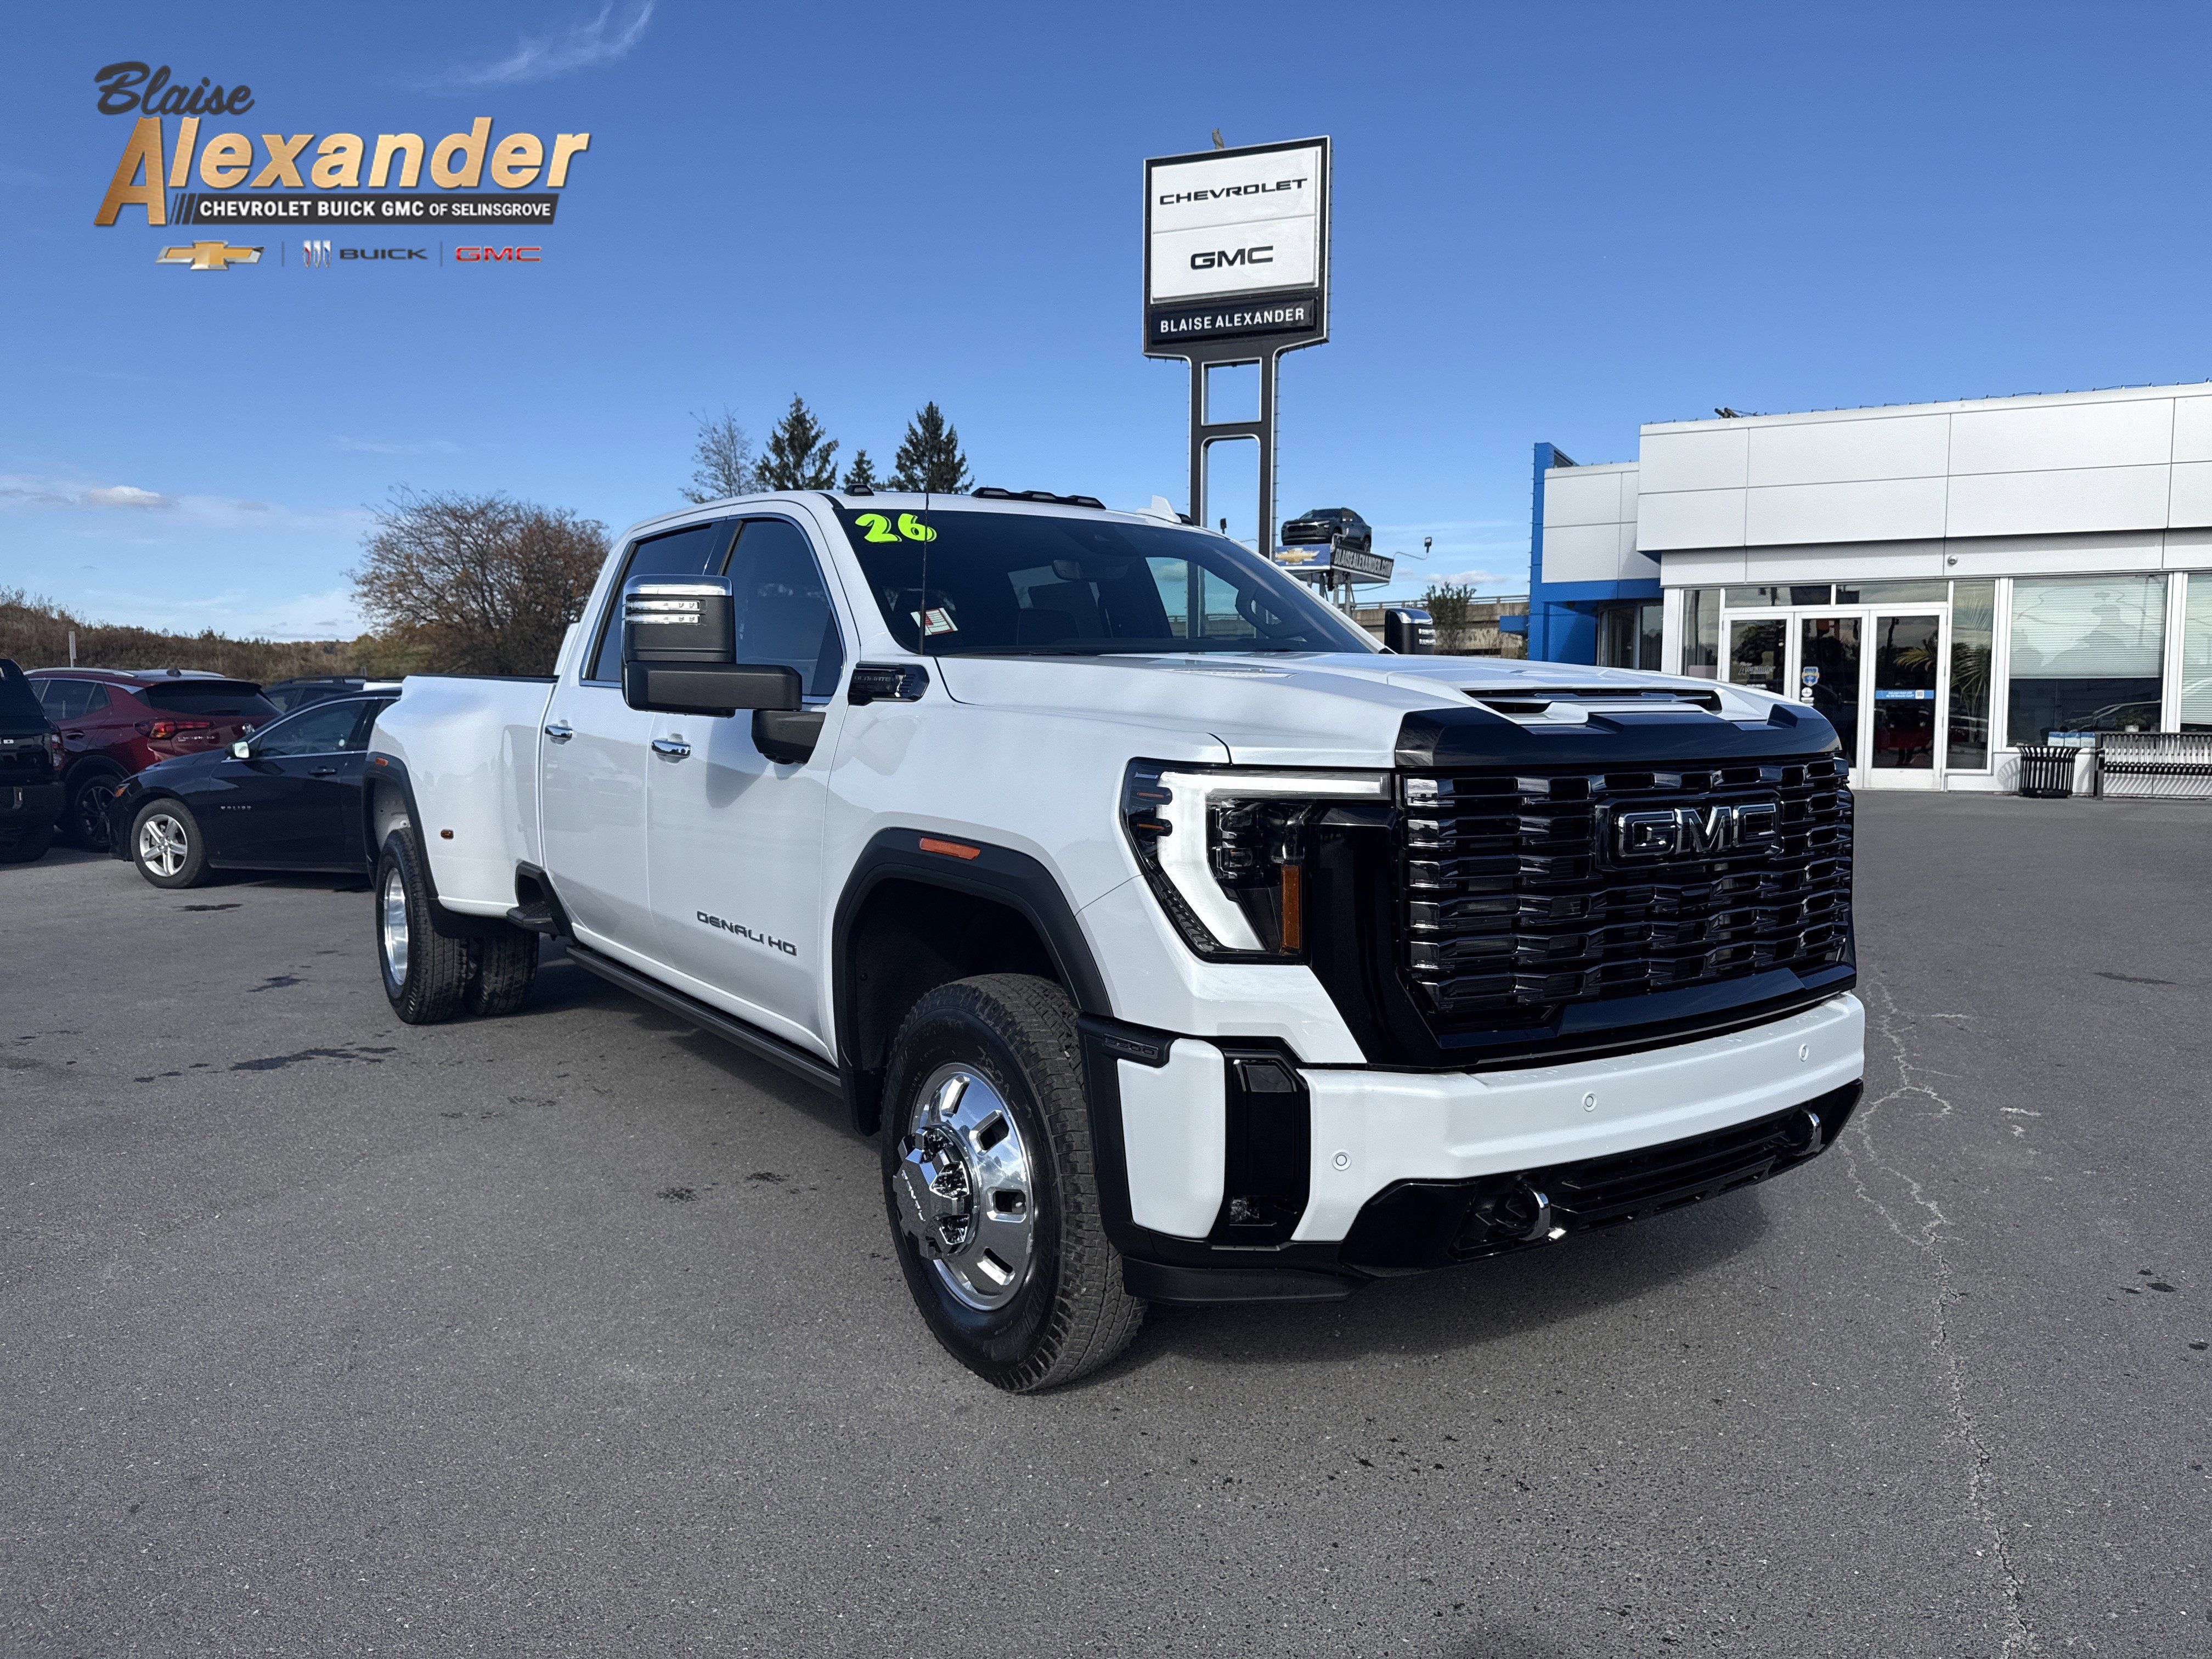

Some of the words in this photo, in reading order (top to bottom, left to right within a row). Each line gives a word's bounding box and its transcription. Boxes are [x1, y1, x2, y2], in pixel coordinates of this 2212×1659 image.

[1160, 178, 1307, 205] CHEVROLET
[1190, 245, 1273, 270] GMC
[1160, 317, 1212, 333] BLAISE
[1215, 308, 1304, 328] ALEXANDER
[855, 513, 937, 543] 26
[1334, 549, 1392, 577] BLAISEALEXANDER.COM
[1618, 803, 1776, 858] GMC
[697, 911, 765, 945] DENALI
[768, 935, 798, 957] HD
